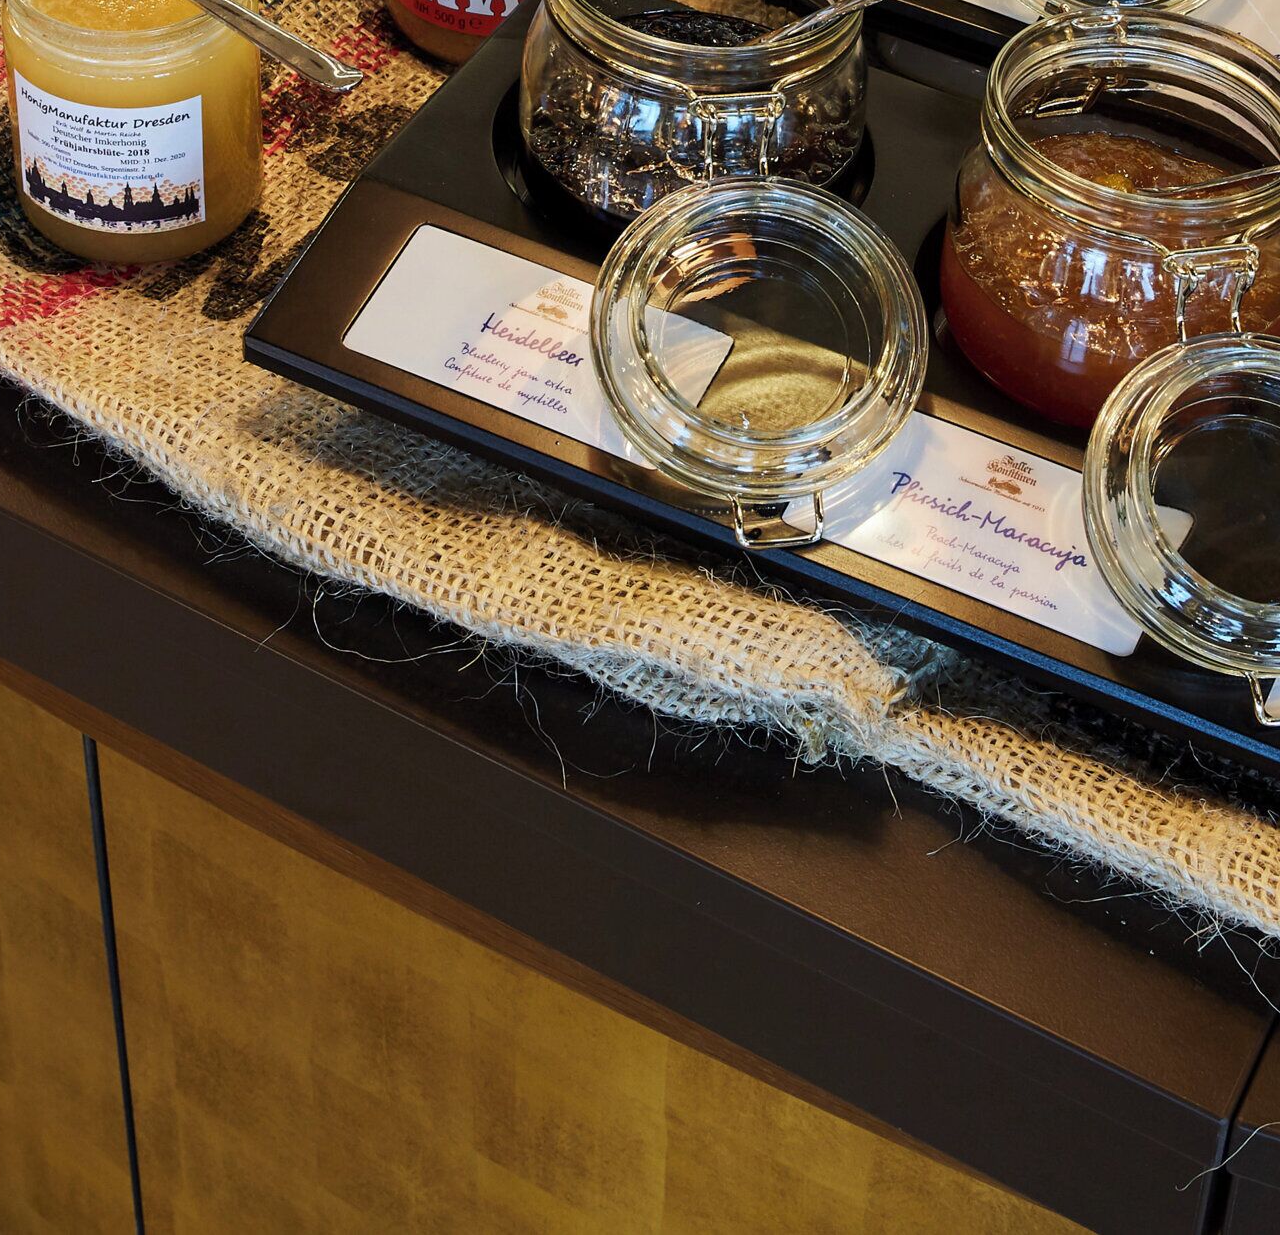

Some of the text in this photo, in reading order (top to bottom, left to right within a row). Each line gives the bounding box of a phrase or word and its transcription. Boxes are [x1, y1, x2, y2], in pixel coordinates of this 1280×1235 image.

[21, 87, 191, 129] HonigManufaktur Dresden
[52, 126, 147, 147] Deutscher Imkerhonig
[127, 149, 150, 157] 2018
[444, 357, 568, 414] Confiture de myrtilles
[461, 342, 572, 395] Blueberry jam extra
[891, 471, 1088, 571] Pfirsich-Maracuja
[926, 525, 1020, 576] Peach-Maracuja
[969, 568, 984, 581] de
[989, 575, 1006, 590] la
[1010, 587, 1059, 611] passion
